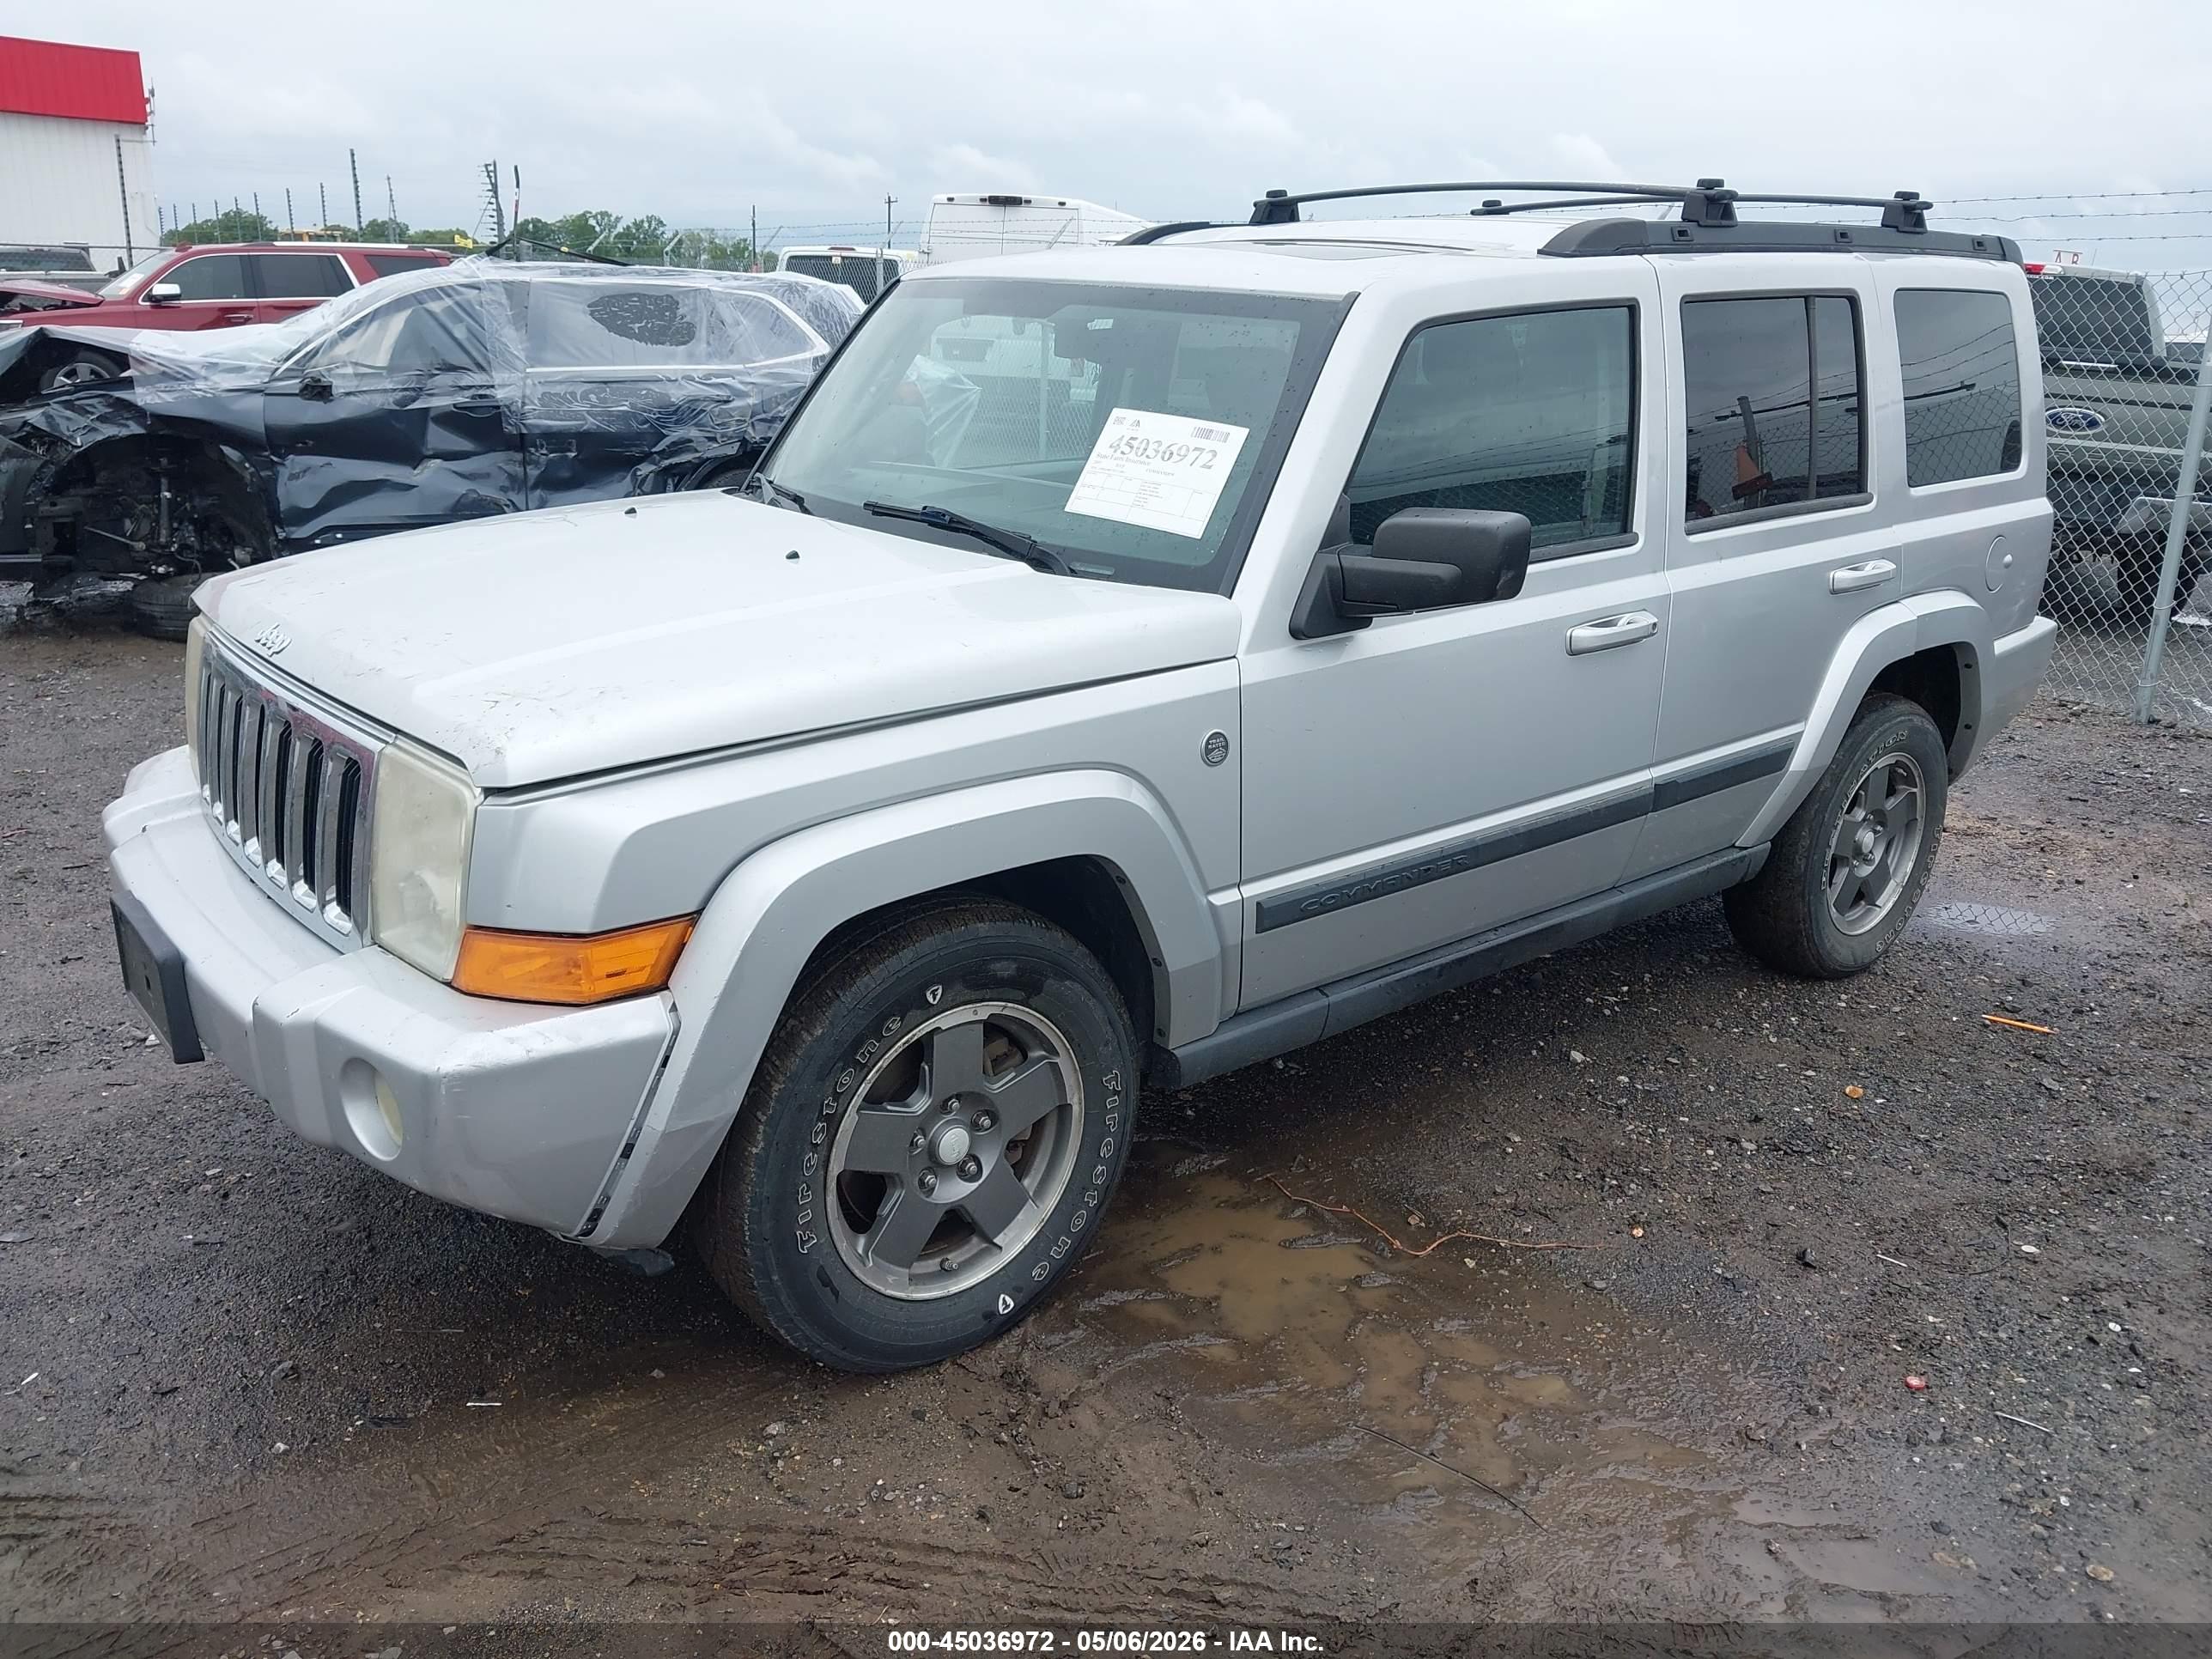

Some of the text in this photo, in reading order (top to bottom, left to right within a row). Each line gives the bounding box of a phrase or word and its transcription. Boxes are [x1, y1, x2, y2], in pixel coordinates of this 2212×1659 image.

[1109, 434, 1218, 470] 45036972
[254, 622, 293, 659] Jeep
[1299, 854, 1471, 913] COMMANDER
[796, 1016, 901, 1254] Firestone
[1031, 1070, 1121, 1281] Firestone
